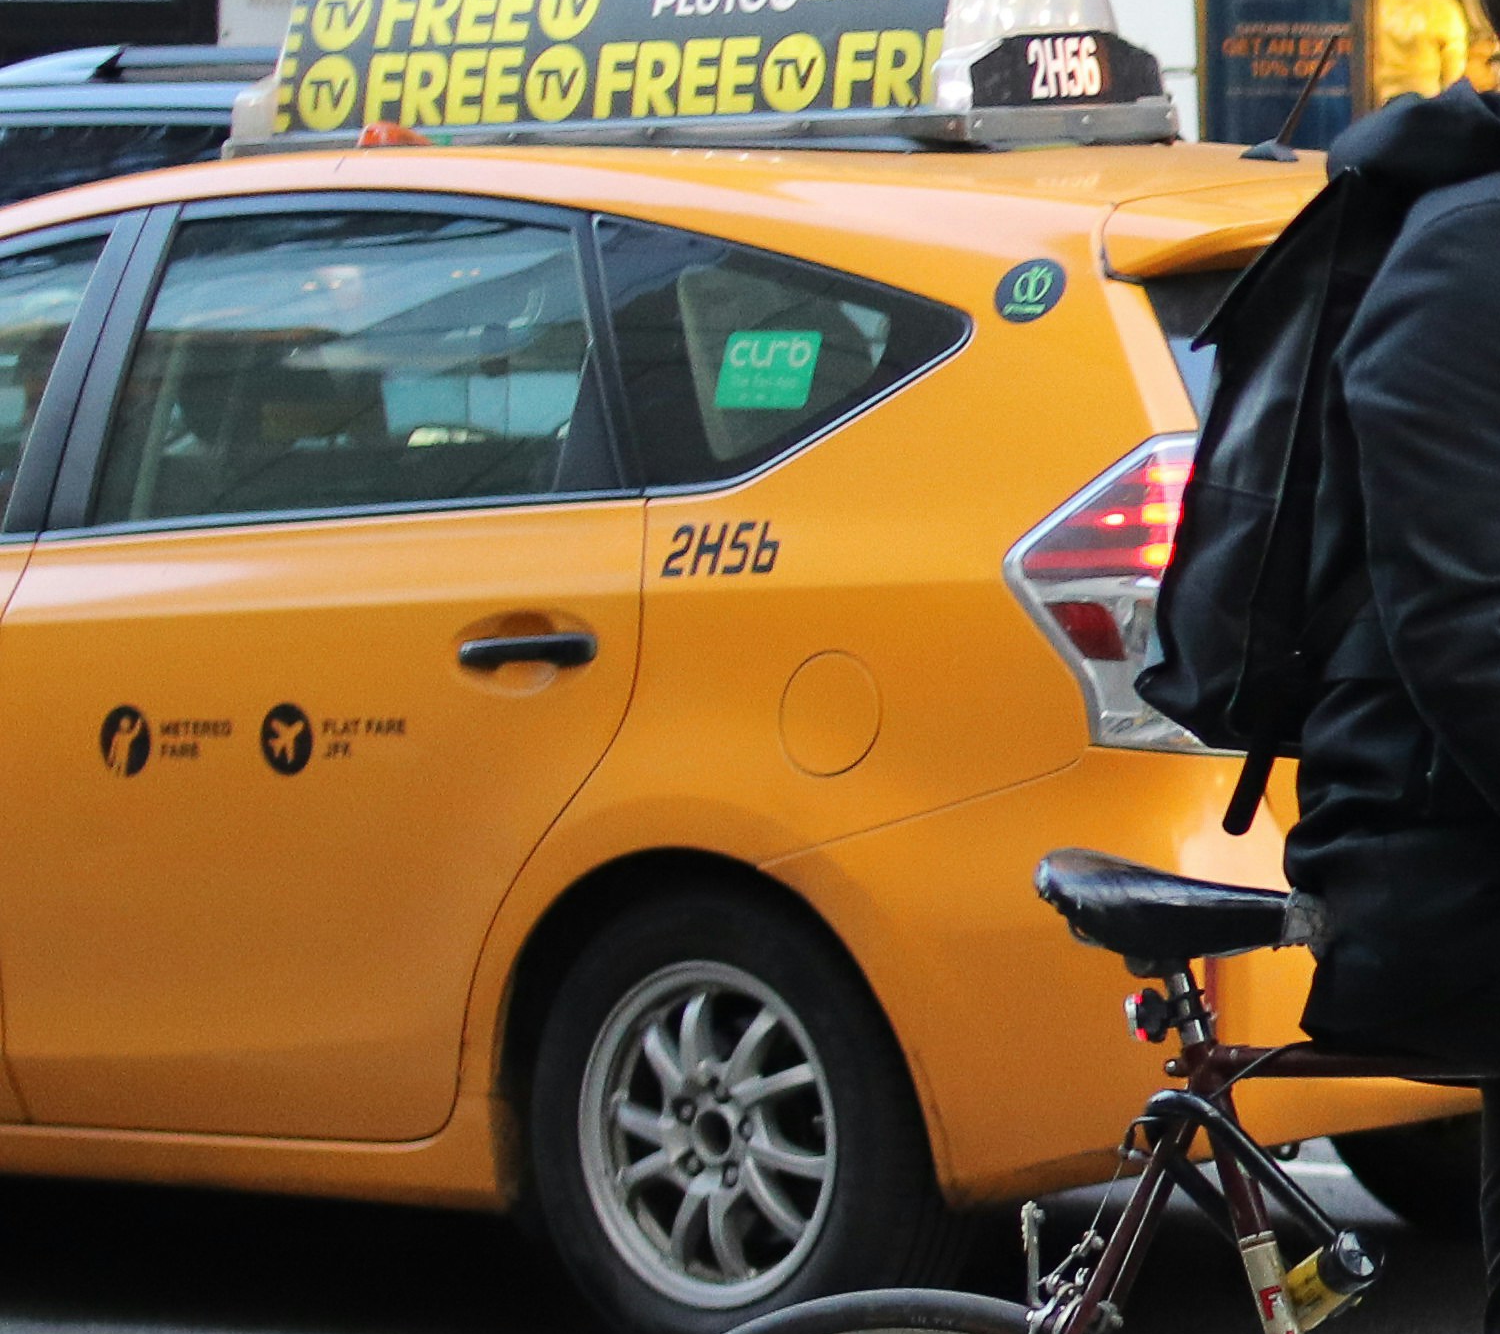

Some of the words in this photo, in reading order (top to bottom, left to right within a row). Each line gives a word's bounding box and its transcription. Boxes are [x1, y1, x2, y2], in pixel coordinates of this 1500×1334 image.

[364, 47, 526, 129] FREE
[593, 36, 762, 120] FREE
[1026, 35, 1101, 100] 2H56
[729, 337, 813, 369] curb
[159, 719, 234, 738] METERED
[321, 718, 362, 736] FLAT
[364, 718, 407, 736] FARE
[159, 742, 200, 759] FARE
